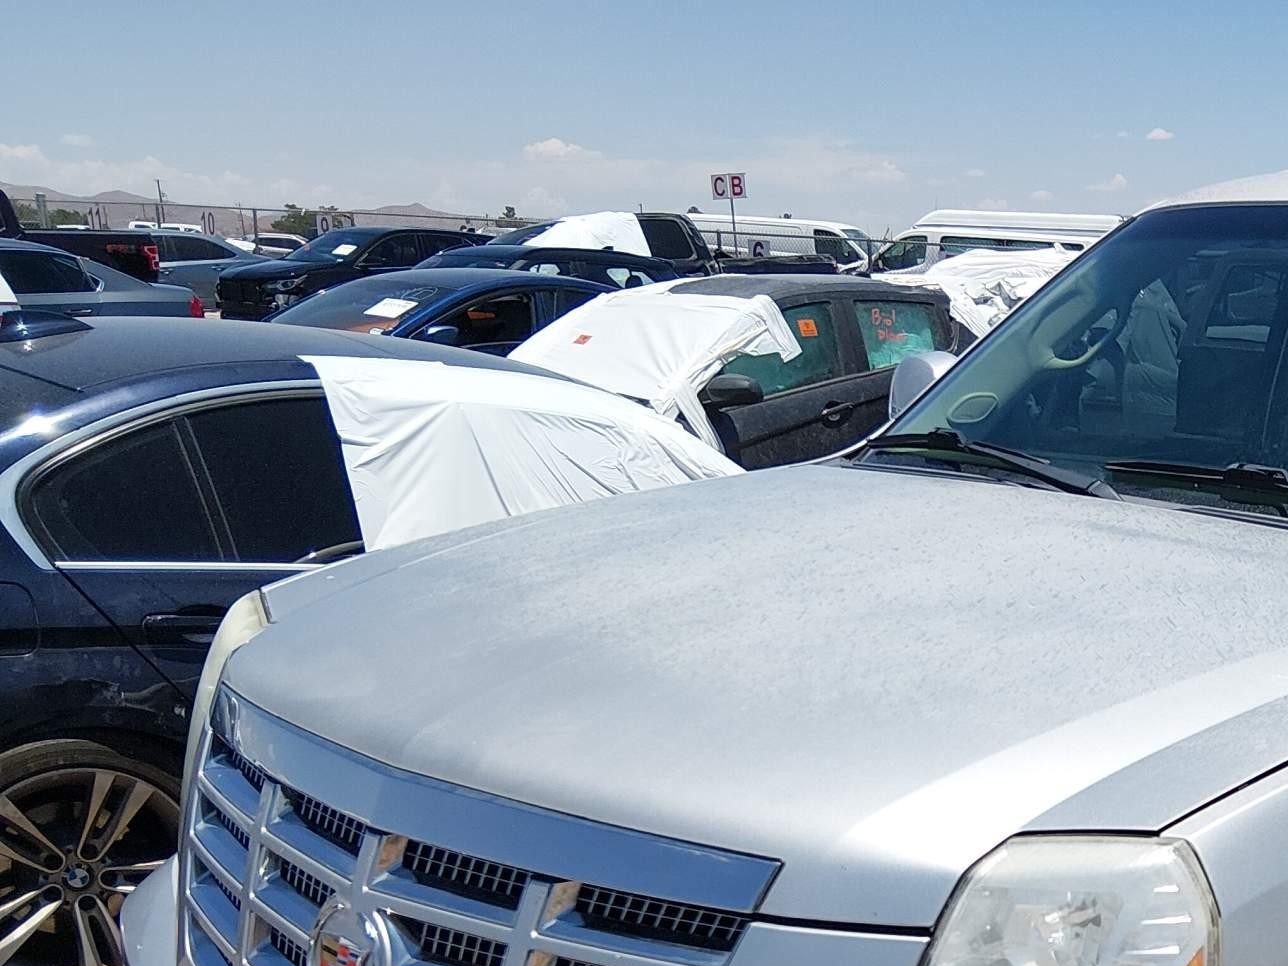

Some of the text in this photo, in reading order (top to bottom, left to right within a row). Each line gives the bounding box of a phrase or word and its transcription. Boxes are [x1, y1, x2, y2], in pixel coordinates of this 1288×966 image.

[714, 176, 744, 197] C B
[88, 206, 102, 230] 11
[201, 211, 215, 235] 10
